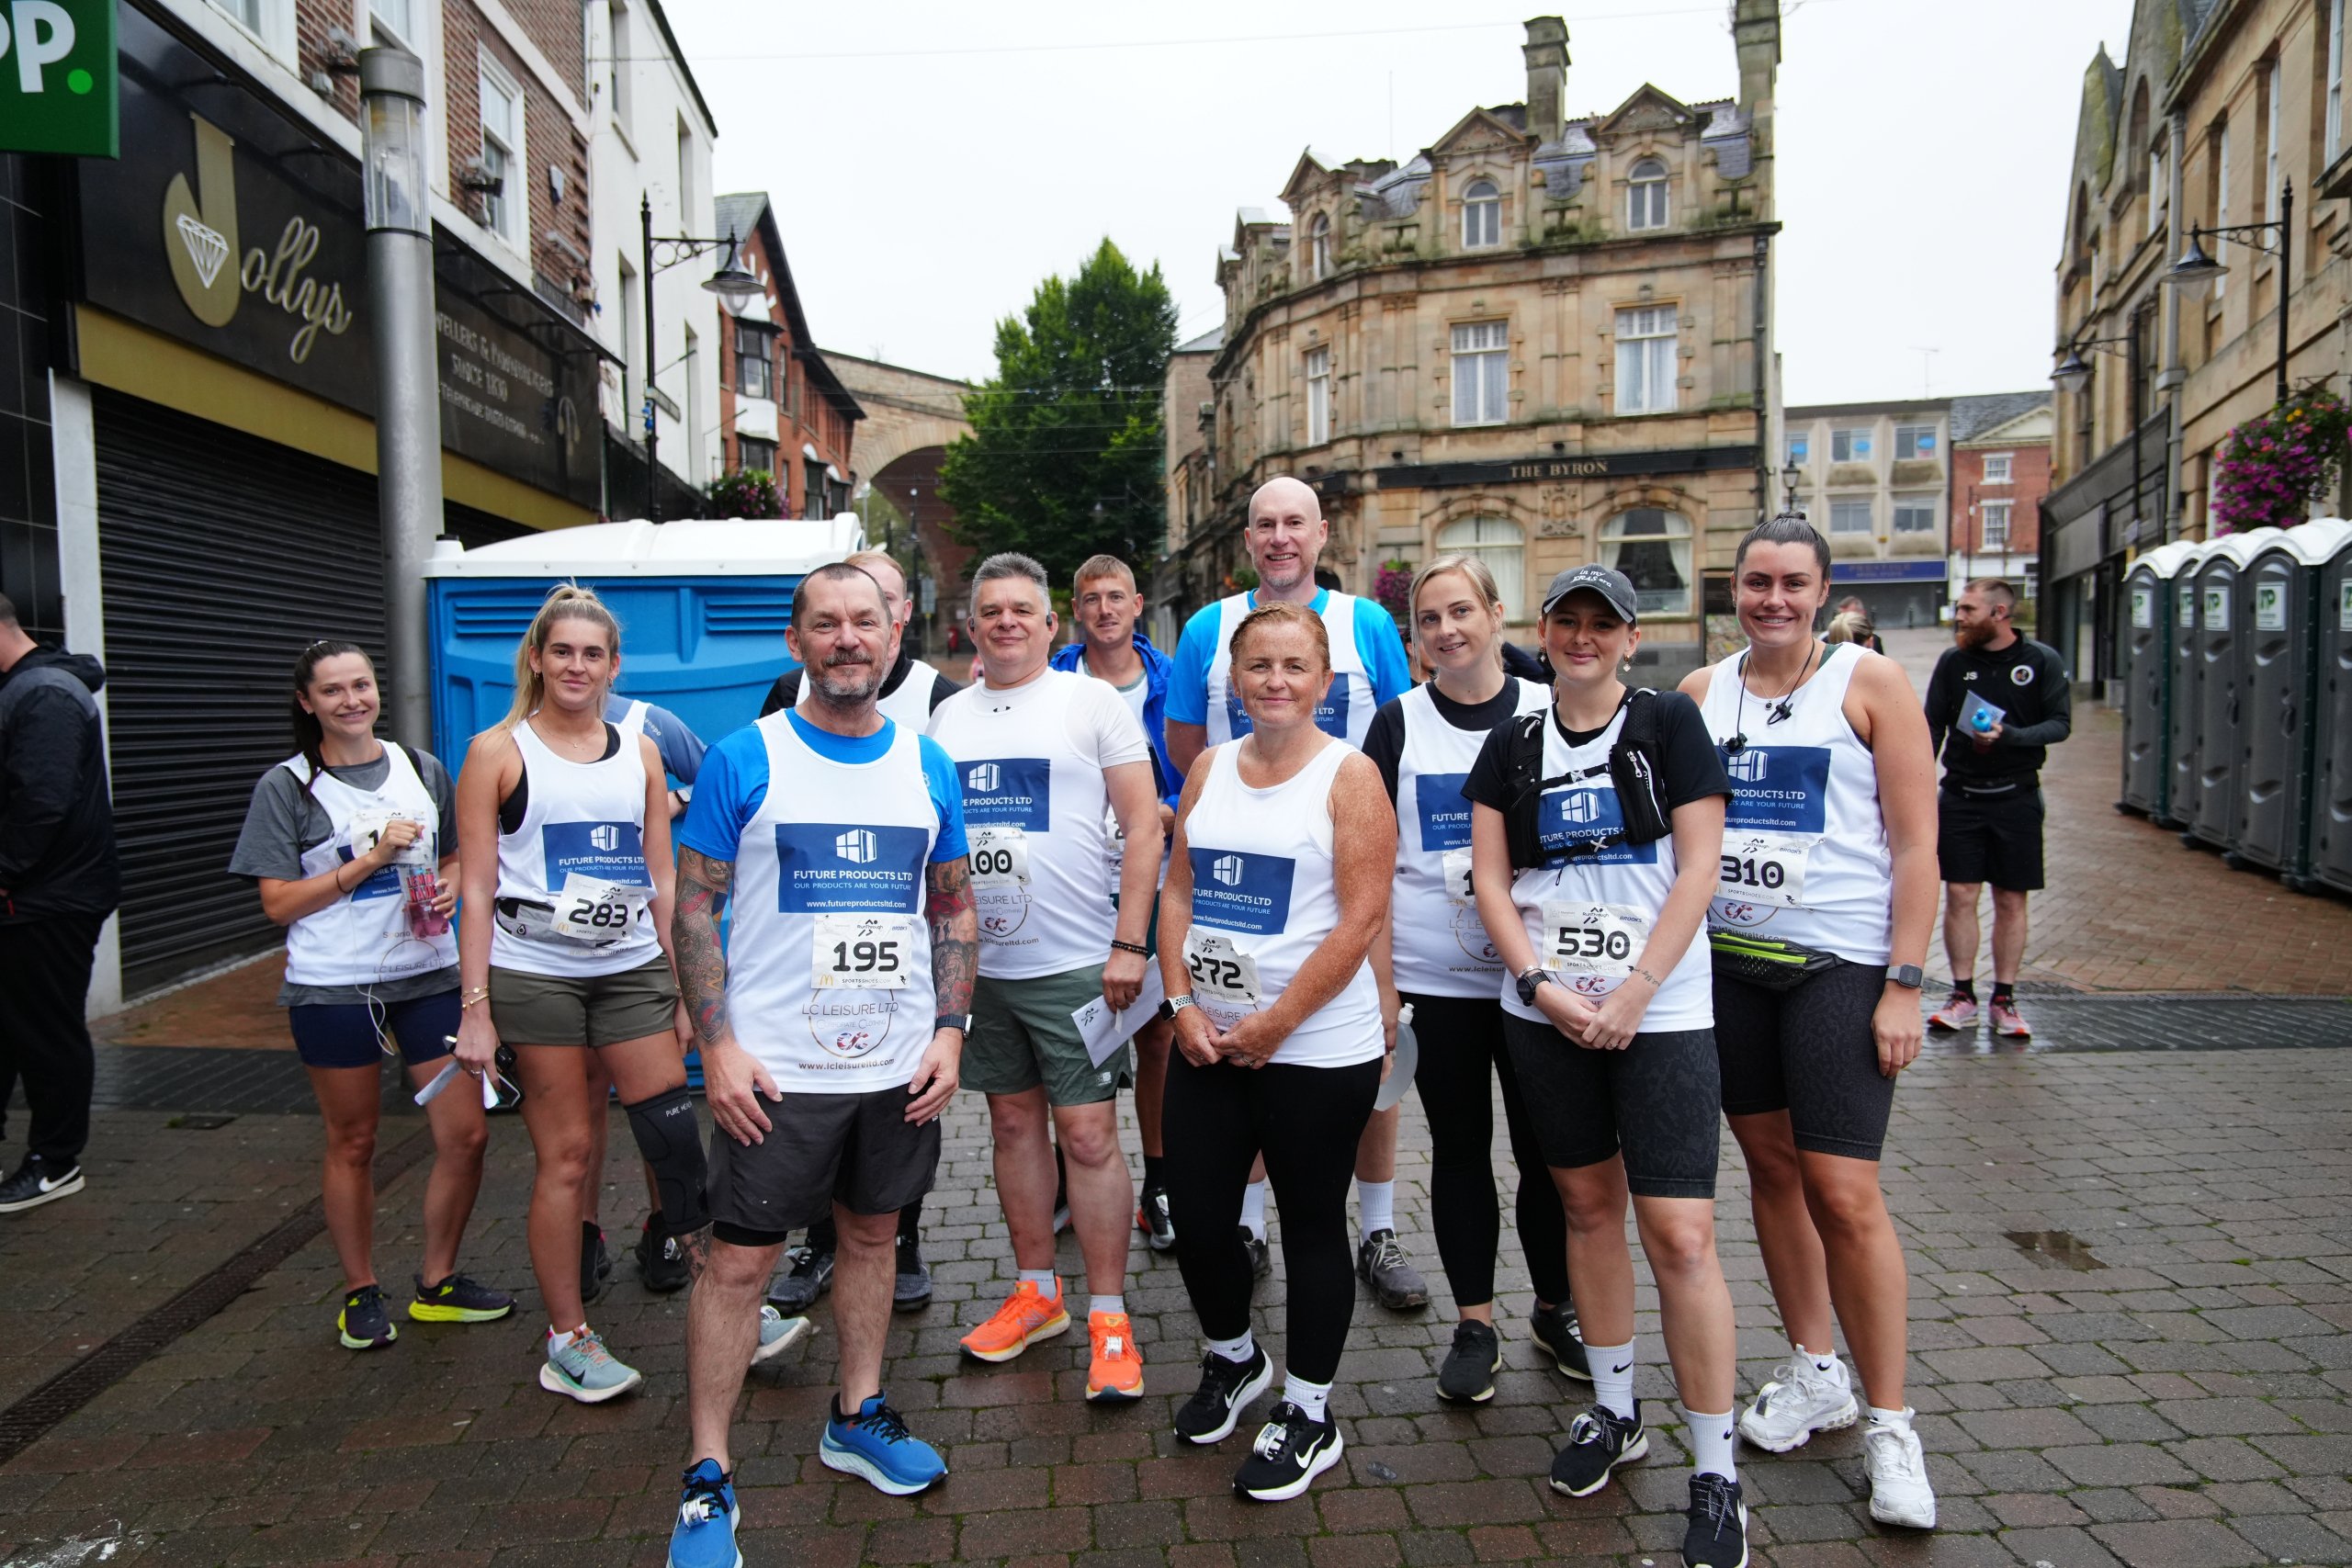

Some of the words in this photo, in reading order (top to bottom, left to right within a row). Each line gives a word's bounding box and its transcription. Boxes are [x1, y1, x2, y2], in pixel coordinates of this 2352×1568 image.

[1510, 465, 1543, 478] THE
[1550, 461, 1609, 476] BYRON
[1963, 671, 1978, 680] JS
[1786, 791, 1806, 800] LTD
[969, 797, 1014, 807] PRODUCTS
[1015, 796, 1033, 805] LTD
[1431, 812, 1469, 822] FUTURE
[1566, 828, 1620, 838] PRODUCTS
[1780, 847, 1802, 855] BROOKS
[559, 856, 594, 866] FUTURE
[595, 856, 633, 864] PRODUCTS
[794, 871, 837, 879] FUTURE
[839, 871, 896, 880] PRODUCTS
[898, 872, 912, 881] LTD
[1721, 855, 1785, 889] 310
[807, 900, 907, 908] www.futureproductsltd.com
[975, 896, 1009, 905] EISURE
[1012, 894, 1033, 904] LTD
[1214, 891, 1253, 904] PRODUCTS
[1253, 897, 1272, 907] LTD
[569, 897, 628, 928] 283
[1195, 899, 1221, 908] PRODUCTS
[1231, 904, 1246, 912] YOUR
[1247, 905, 1271, 915] FUTURE
[1449, 919, 1464, 929] LC
[1556, 927, 1631, 961] 530
[832, 941, 899, 972] 195
[373, 965, 388, 974] LC
[390, 962, 427, 973] LEISURE
[429, 957, 446, 968] LTD
[1191, 953, 1244, 988] 272
[802, 1004, 820, 1015] LC
[822, 1003, 876, 1016] LEISURE
[877, 1002, 899, 1013] LTD
[858, 1019, 887, 1029] CLOTHING
[798, 1058, 895, 1070] www.lcleisureltd.com
[665, 1106, 680, 1117] PURE
